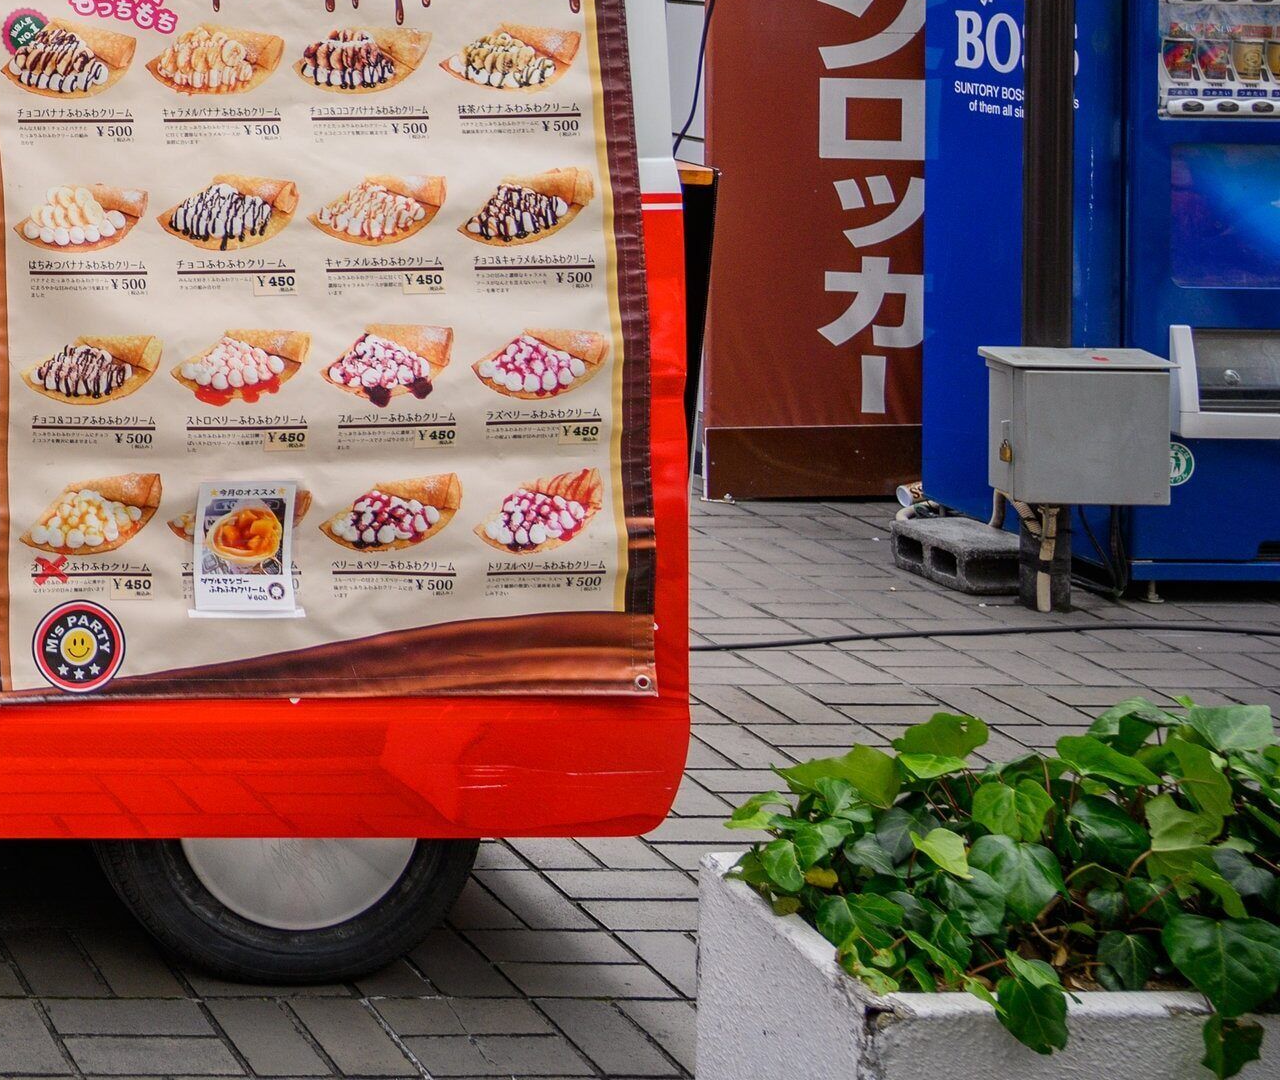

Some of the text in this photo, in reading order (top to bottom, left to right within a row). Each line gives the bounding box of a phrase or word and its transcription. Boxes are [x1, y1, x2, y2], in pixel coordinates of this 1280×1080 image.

[954, 80, 1000, 99] SUNTORY
[17, 107, 133, 119] チョコバナナふわふわクリーム
[161, 106, 281, 119] キャラメルバナナふわふわクリーム
[457, 102, 580, 115] 抹茶バナナふわふわクリーム
[968, 99, 1013, 117] of them all
[28, 260, 147, 270] はちみつバナナふわふわクリーム
[176, 258, 287, 270] チョコふわふわクリーム
[324, 256, 443, 268] キャラメルふわふわクリーム
[486, 408, 601, 420] ラズベリーふわふわクリーム
[186, 415, 308, 426] ストロベリーふわふわクリーム
[218, 487, 277, 497] 今月のオススメ
[45, 614, 111, 654] M's PARTY
